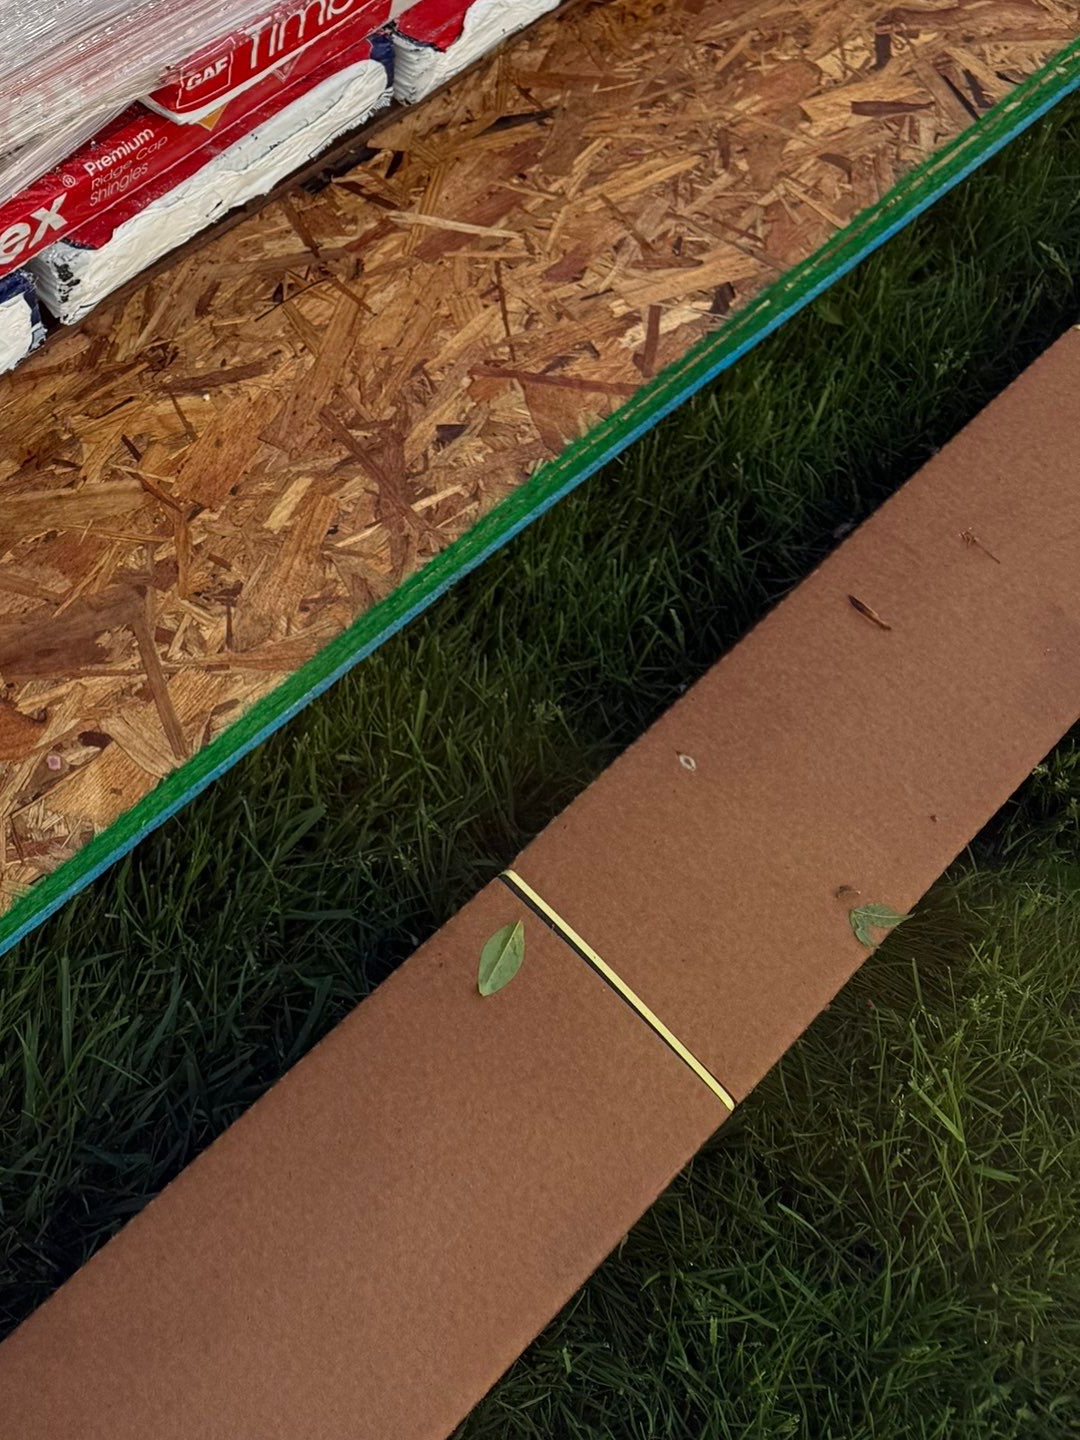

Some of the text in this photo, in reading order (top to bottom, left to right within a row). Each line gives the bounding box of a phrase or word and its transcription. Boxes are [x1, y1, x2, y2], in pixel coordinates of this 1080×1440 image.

[185, 55, 229, 92] GAF
[83, 127, 155, 177] Premium
[91, 136, 168, 191] Ridge Cap
[89, 162, 149, 207] Shingles
